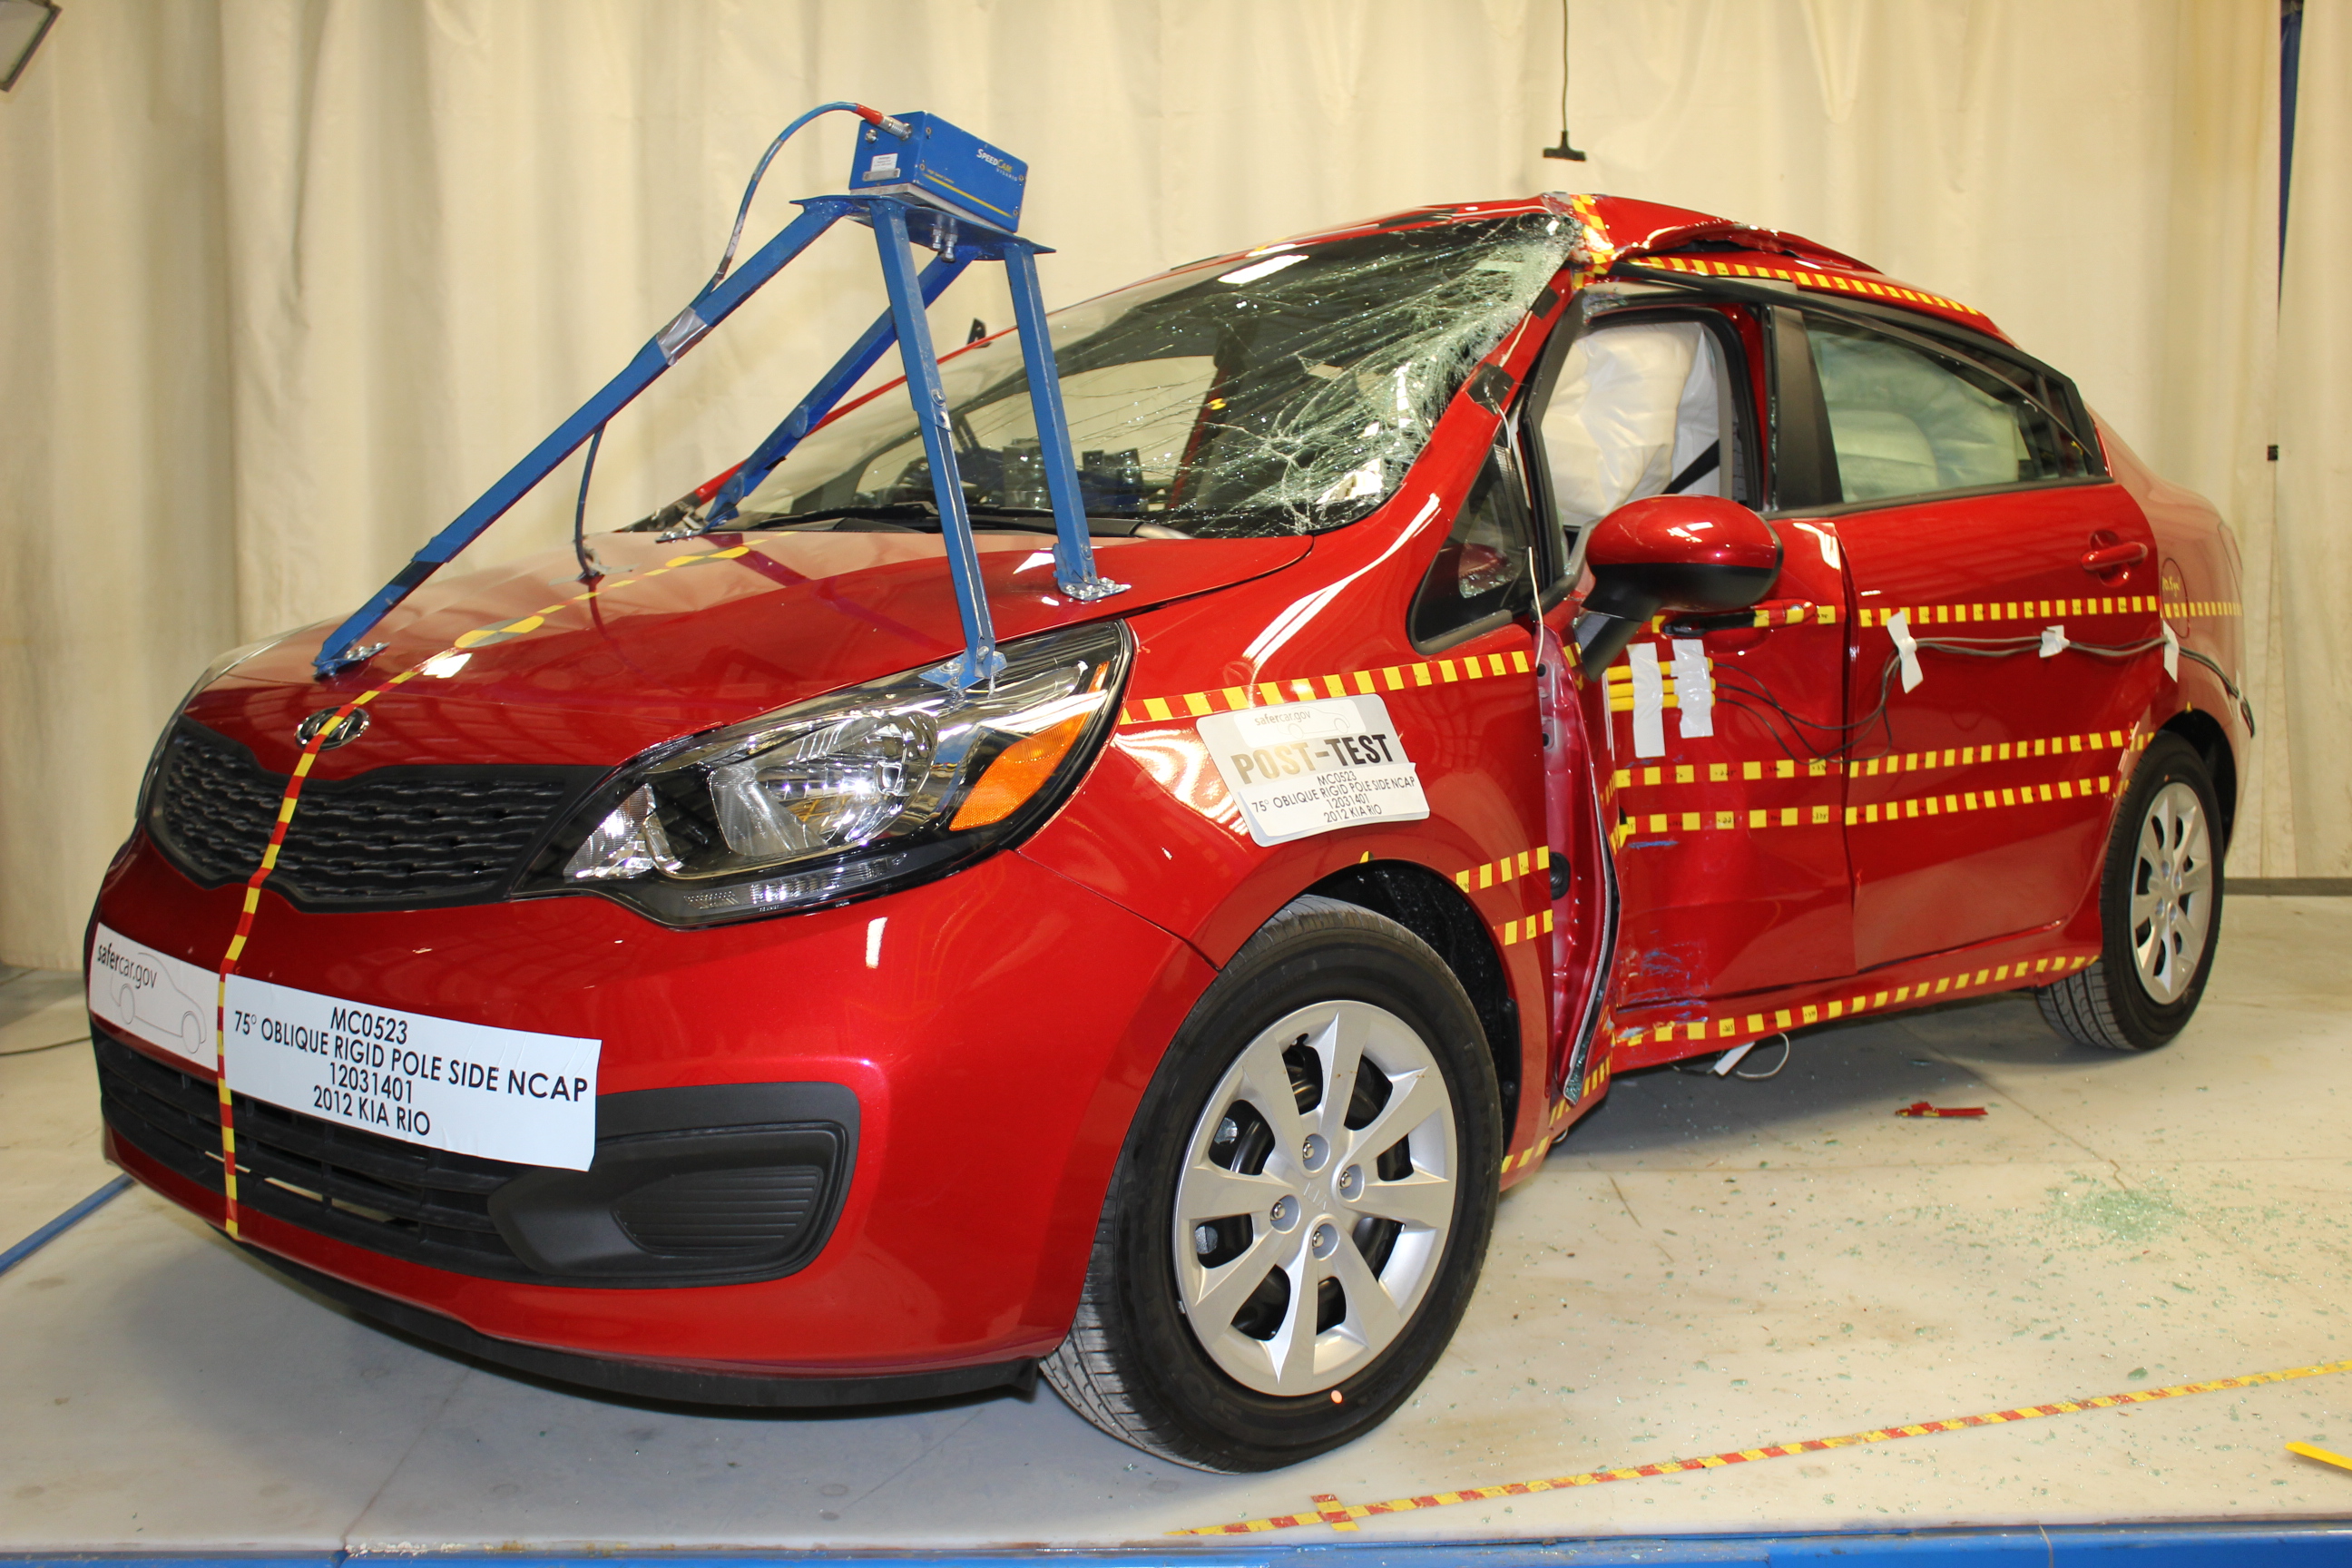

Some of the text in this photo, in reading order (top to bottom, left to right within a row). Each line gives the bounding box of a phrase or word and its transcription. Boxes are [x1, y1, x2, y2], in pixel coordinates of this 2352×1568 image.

[1254, 710, 1311, 726] safercar.gov
[1272, 789, 1320, 808] OBLIQUE
[1319, 785, 1348, 799] RIGID
[1350, 780, 1372, 793] POLE
[1373, 779, 1391, 790] SIDE
[1391, 776, 1416, 789] NCAP
[1317, 770, 1357, 786] MC0523
[1323, 804, 1382, 823] 2012 KIA RIO
[1326, 793, 1370, 809] 12031401
[97, 942, 158, 990] safercar.gov
[329, 1007, 407, 1044] MC0523
[261, 1018, 328, 1056] OBLIQUE
[335, 1035, 385, 1068] RIGID
[392, 1049, 442, 1082] POLE
[449, 1060, 499, 1092] SIDE
[507, 1070, 588, 1102] NCAP
[329, 1062, 412, 1104] 12031401
[313, 1085, 430, 1136] 2012 KIA RIO
